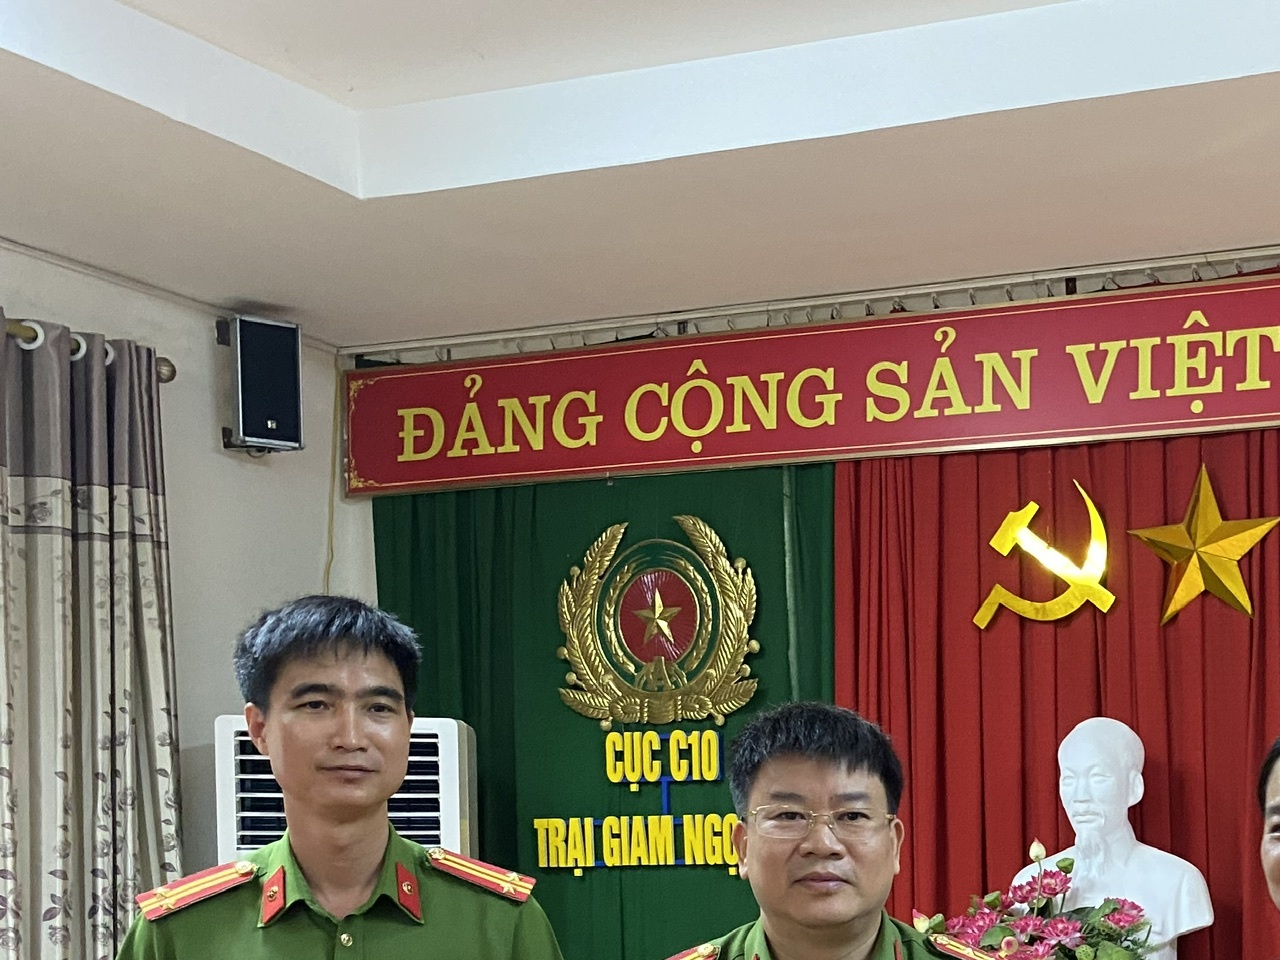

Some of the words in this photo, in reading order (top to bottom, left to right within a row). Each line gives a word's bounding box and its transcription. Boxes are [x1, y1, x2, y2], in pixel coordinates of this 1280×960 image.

[397, 374, 603, 462] ĐẢNG
[624, 358, 843, 453] CỘNG
[866, 326, 1037, 422] SẢN
[605, 730, 662, 792] CỤC
[669, 729, 720, 781] C10
[533, 817, 596, 877] TRẠI
[602, 815, 676, 868] GIAM
[683, 813, 739, 876] NGỌ
